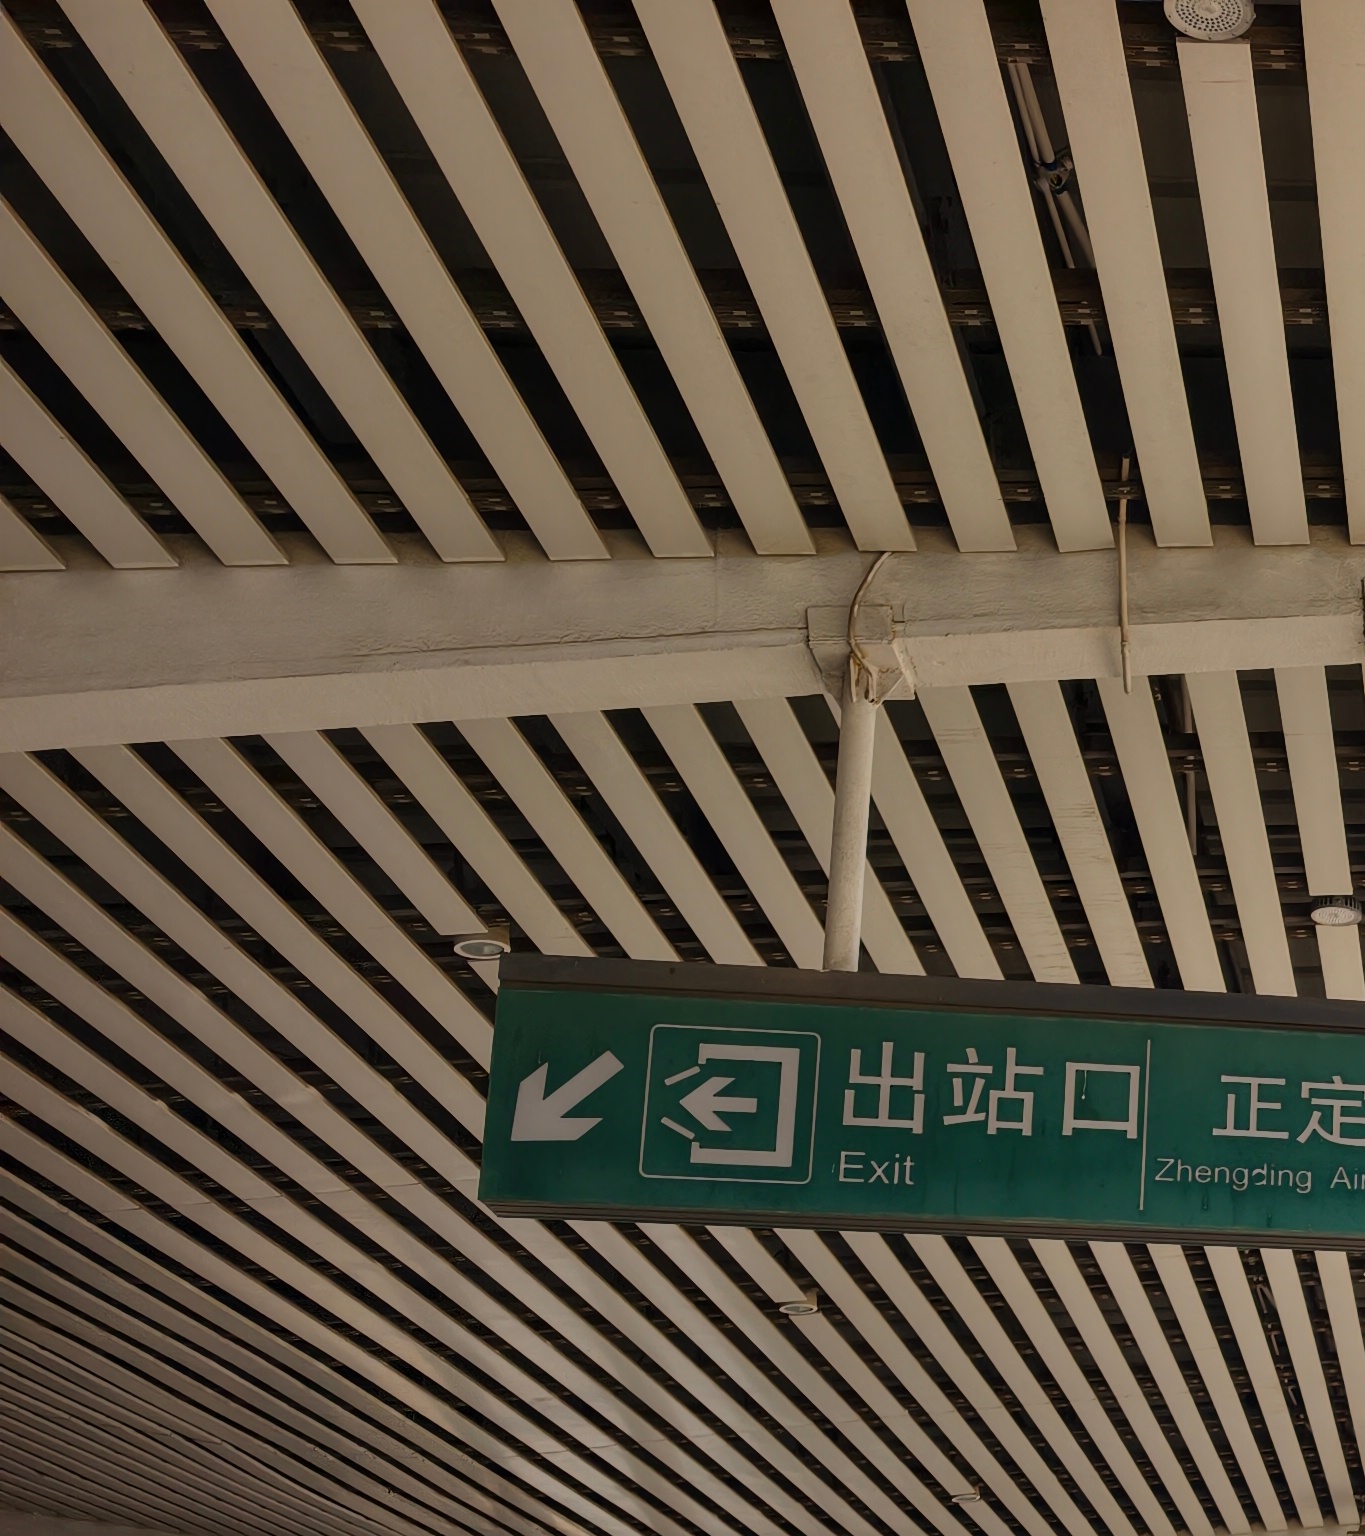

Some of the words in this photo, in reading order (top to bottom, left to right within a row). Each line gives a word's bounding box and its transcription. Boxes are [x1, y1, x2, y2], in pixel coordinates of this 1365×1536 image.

[843, 1041, 1140, 1139] 出站口
[838, 1151, 915, 1185] Exit
[1155, 1157, 1312, 1194] Zhengding
